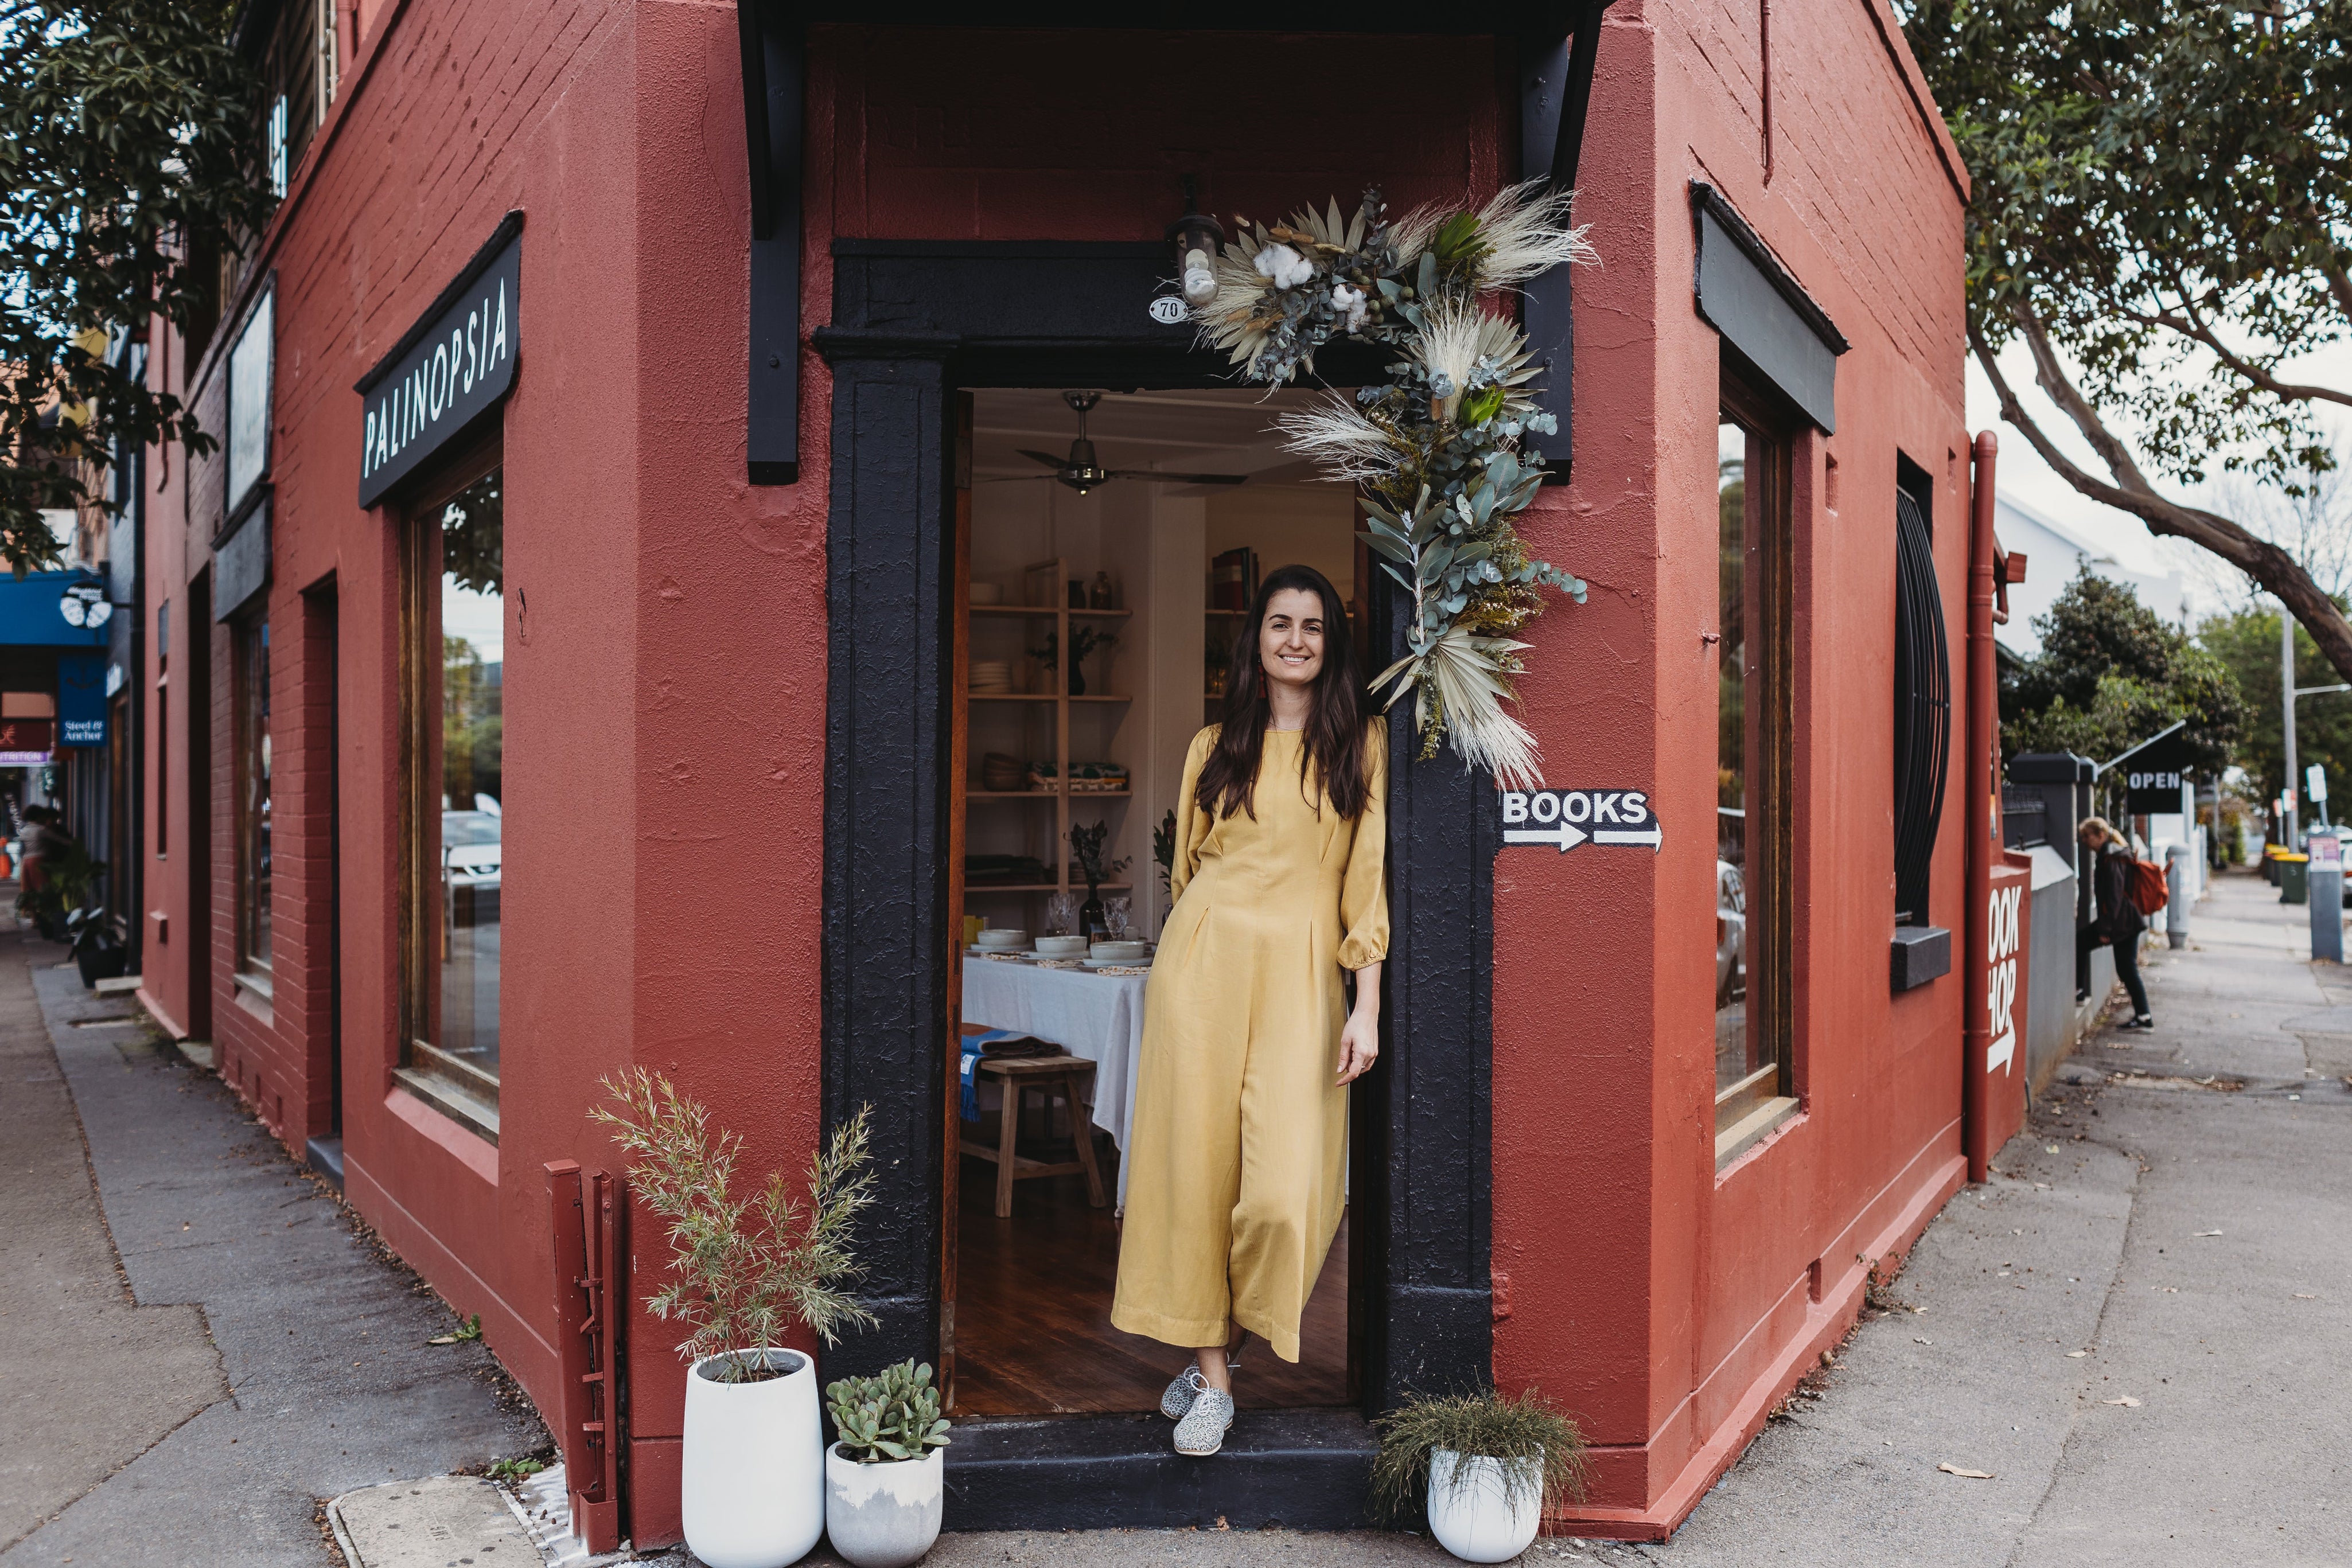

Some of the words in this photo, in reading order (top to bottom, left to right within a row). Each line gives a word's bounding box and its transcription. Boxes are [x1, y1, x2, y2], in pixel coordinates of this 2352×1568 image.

[1161, 303, 1178, 317] 70
[365, 277, 506, 478] PALINOPSIA
[65, 730, 102, 740] Anchor
[2129, 772, 2179, 789] OPEN
[1503, 792, 1647, 823] BOOKS
[1988, 886, 2022, 964] OOK
[1988, 958, 2016, 1037] HOP
